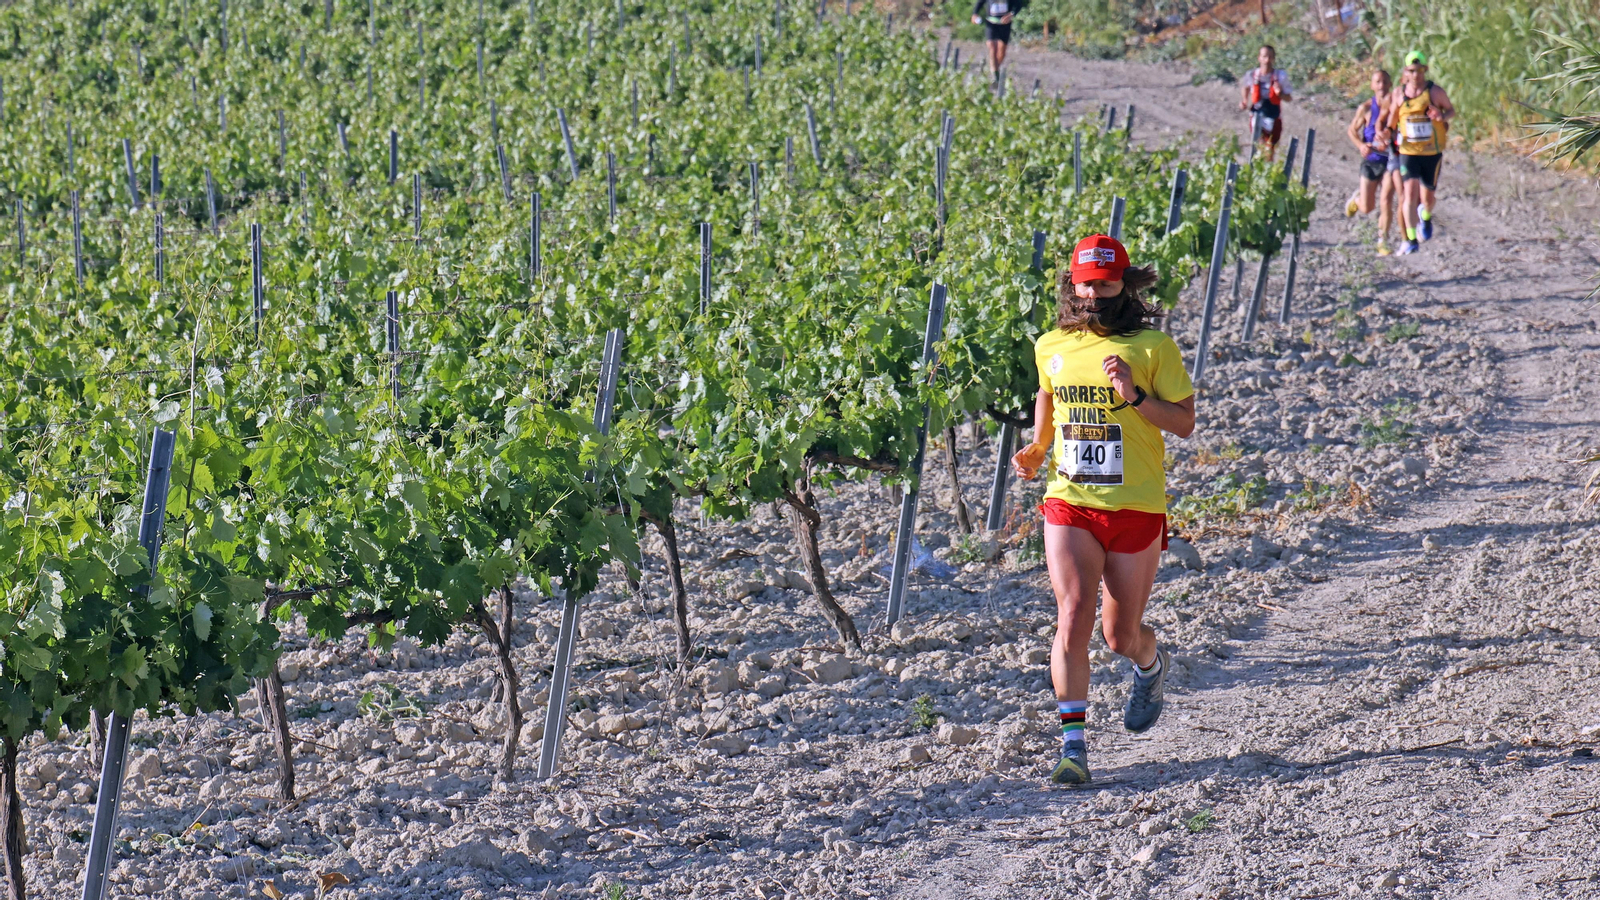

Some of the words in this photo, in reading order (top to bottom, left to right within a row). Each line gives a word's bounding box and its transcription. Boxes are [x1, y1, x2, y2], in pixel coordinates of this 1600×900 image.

[1054, 386, 1115, 404] FORREST
[1068, 407, 1106, 424] WINE
[1073, 425, 1103, 437] Sherry
[1073, 444, 1106, 465] 140
